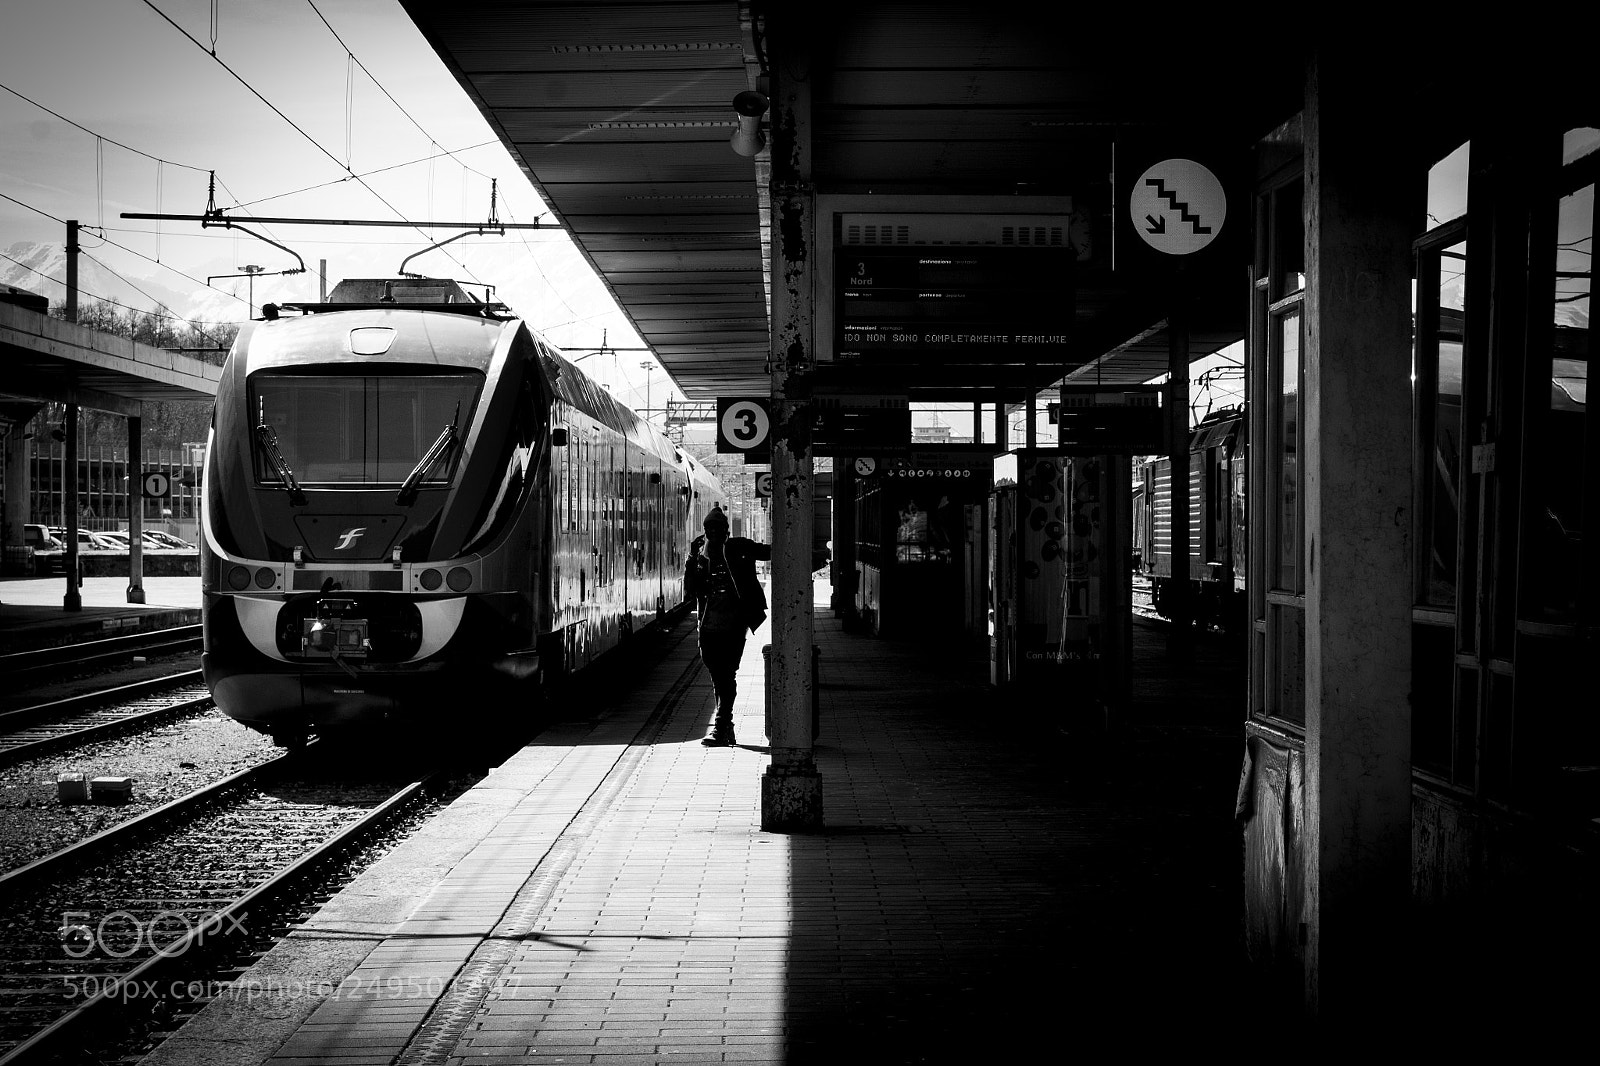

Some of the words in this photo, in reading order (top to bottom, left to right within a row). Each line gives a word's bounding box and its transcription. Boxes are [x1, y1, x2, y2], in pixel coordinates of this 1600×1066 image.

[857, 262, 866, 276] 3
[850, 277, 873, 286] Nord
[866, 333, 886, 343] NON
[892, 334, 919, 343] SONO
[924, 334, 1009, 344] COMPLETAMENTE
[733, 409, 758, 441] 3
[152, 478, 159, 493] 1
